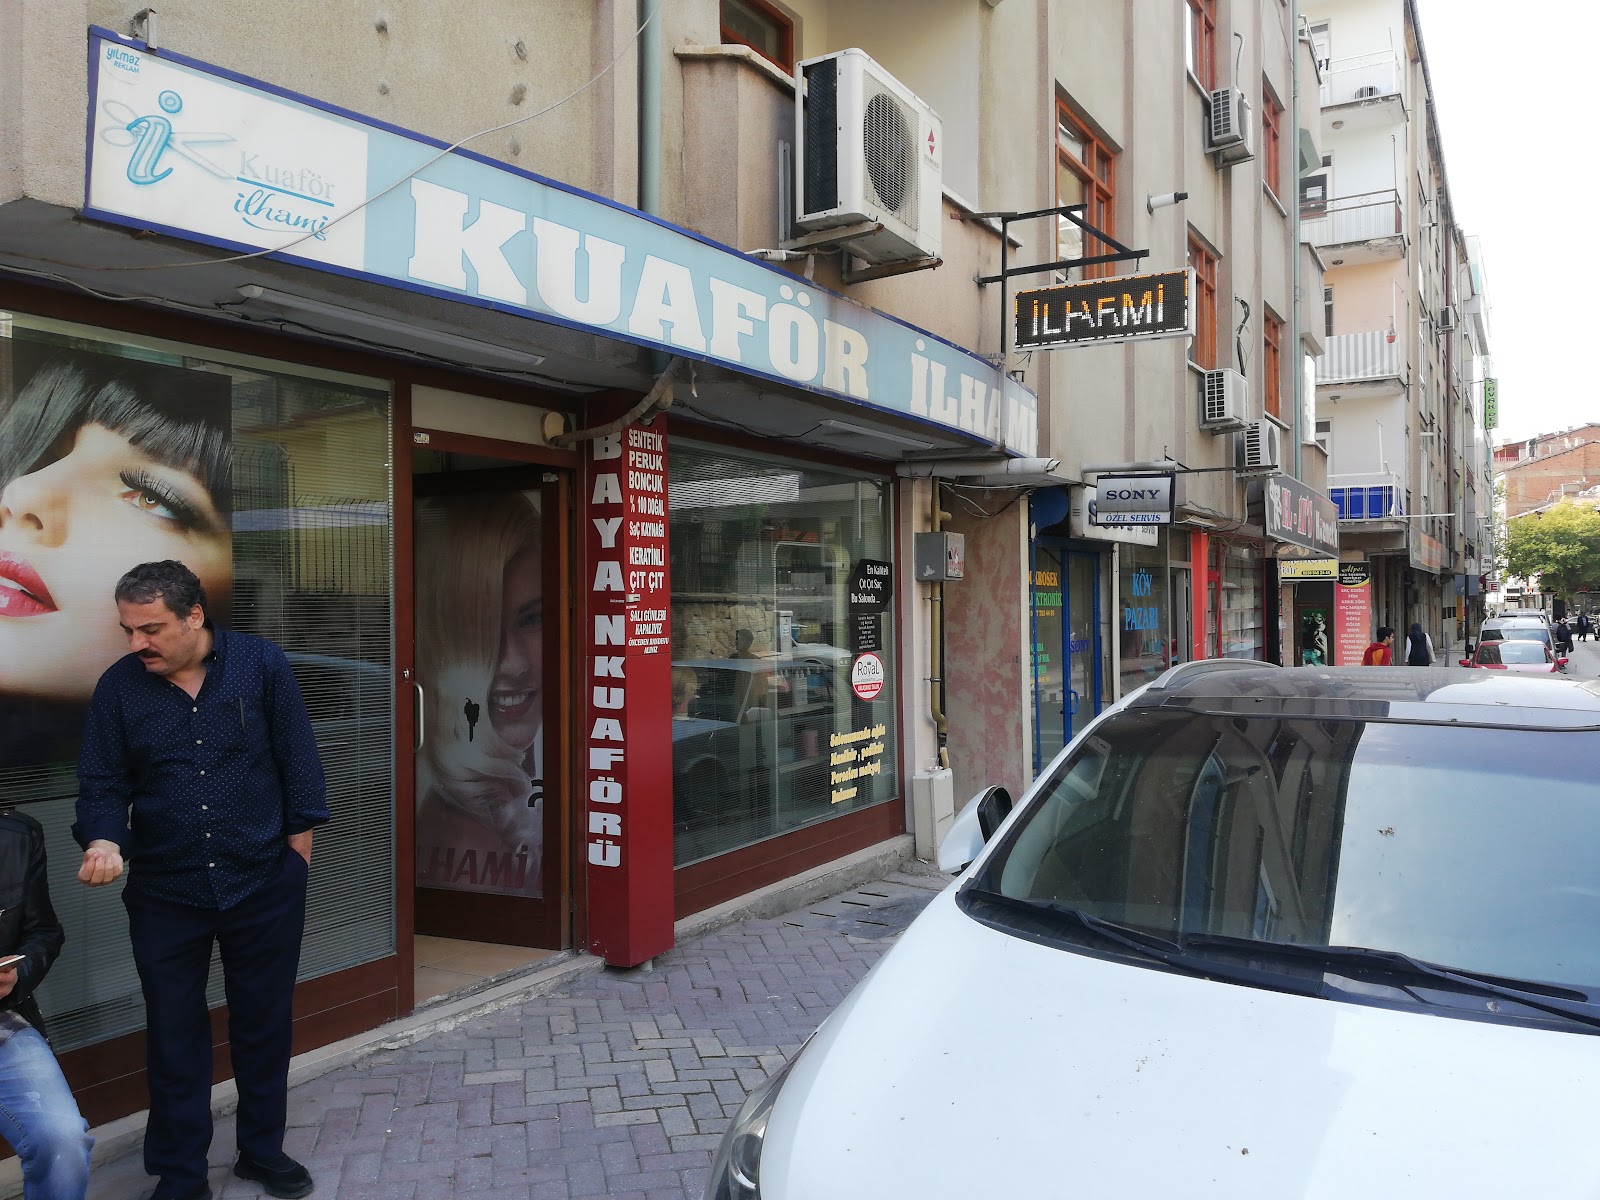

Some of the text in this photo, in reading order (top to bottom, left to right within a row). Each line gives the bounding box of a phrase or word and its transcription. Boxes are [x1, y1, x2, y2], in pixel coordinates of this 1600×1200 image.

[114, 61, 140, 74] REKLAM
[239, 150, 335, 199] Kuaför
[407, 176, 1038, 457] KUAFÖR İLHAMİ
[628, 428, 664, 452] SENTETİK
[628, 450, 664, 472] PERUK
[628, 470, 664, 493] BONCUK
[638, 495, 647, 514] 100
[647, 495, 665, 516] DOĞAL
[1106, 489, 1161, 500] SONY
[1105, 512, 1161, 522] ÖZEL SERVİS
[591, 431, 626, 646] BAYAN
[641, 520, 665, 538] KAYNAĞI
[629, 544, 665, 566] KERATİNLİ
[866, 565, 874, 575] En
[629, 570, 665, 593] ÇIT ÇIT
[1131, 568, 1153, 597] KÖY
[1490, 583, 1498, 591] E
[630, 606, 667, 621] SALI GÜNLERİ
[1125, 607, 1159, 631] PAZARI
[588, 655, 626, 868] KUAFÖRÜ
